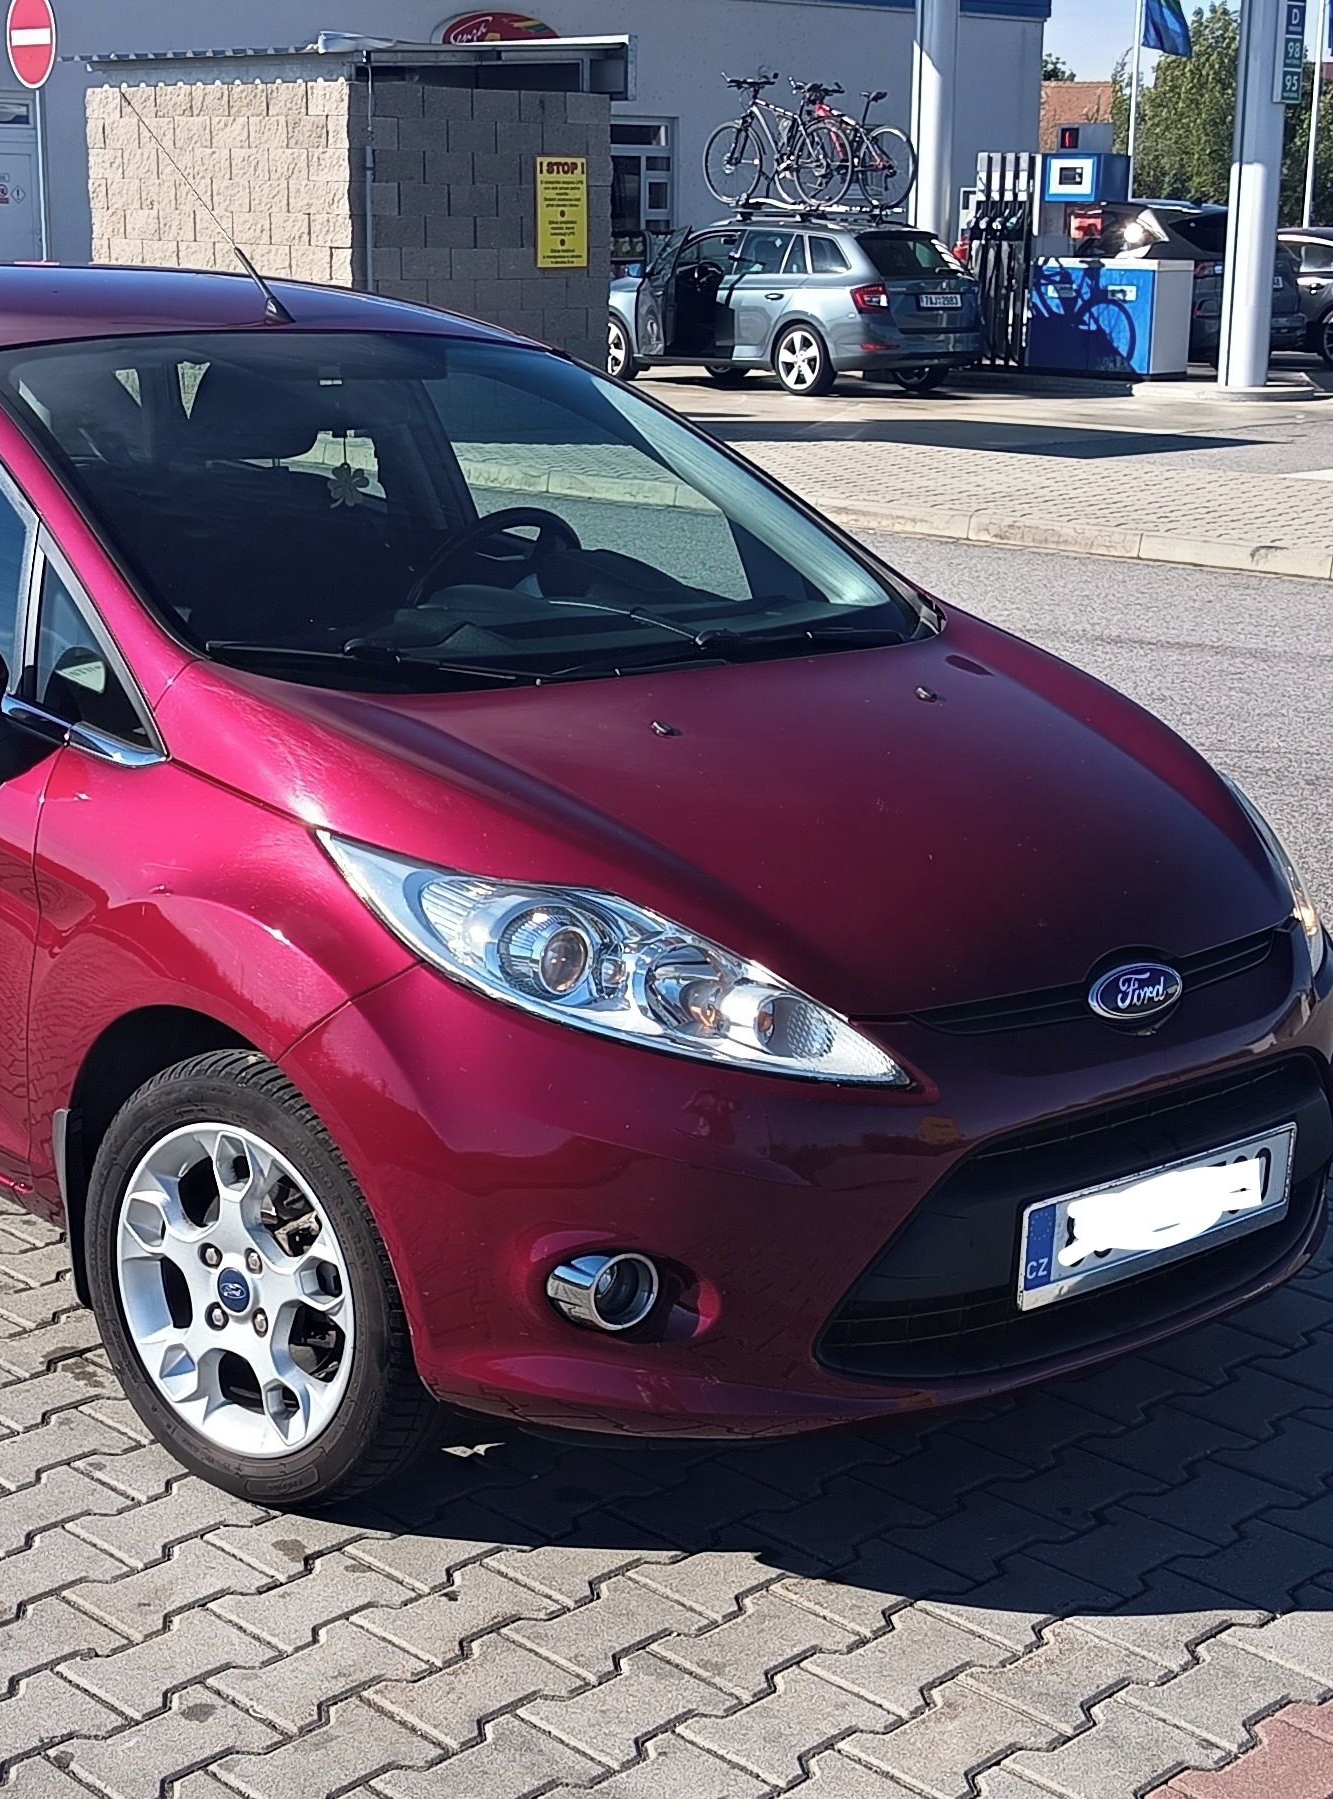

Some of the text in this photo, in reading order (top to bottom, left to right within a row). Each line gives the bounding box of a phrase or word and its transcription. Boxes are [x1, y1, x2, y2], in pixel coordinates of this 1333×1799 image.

[1291, 8, 1300, 24] D
[1287, 41, 1301, 58] 98
[1285, 74, 1298, 91] 95
[546, 161, 578, 175] STOP
[1117, 972, 1166, 1009] Ford
[1026, 1257, 1048, 1280] CZ
